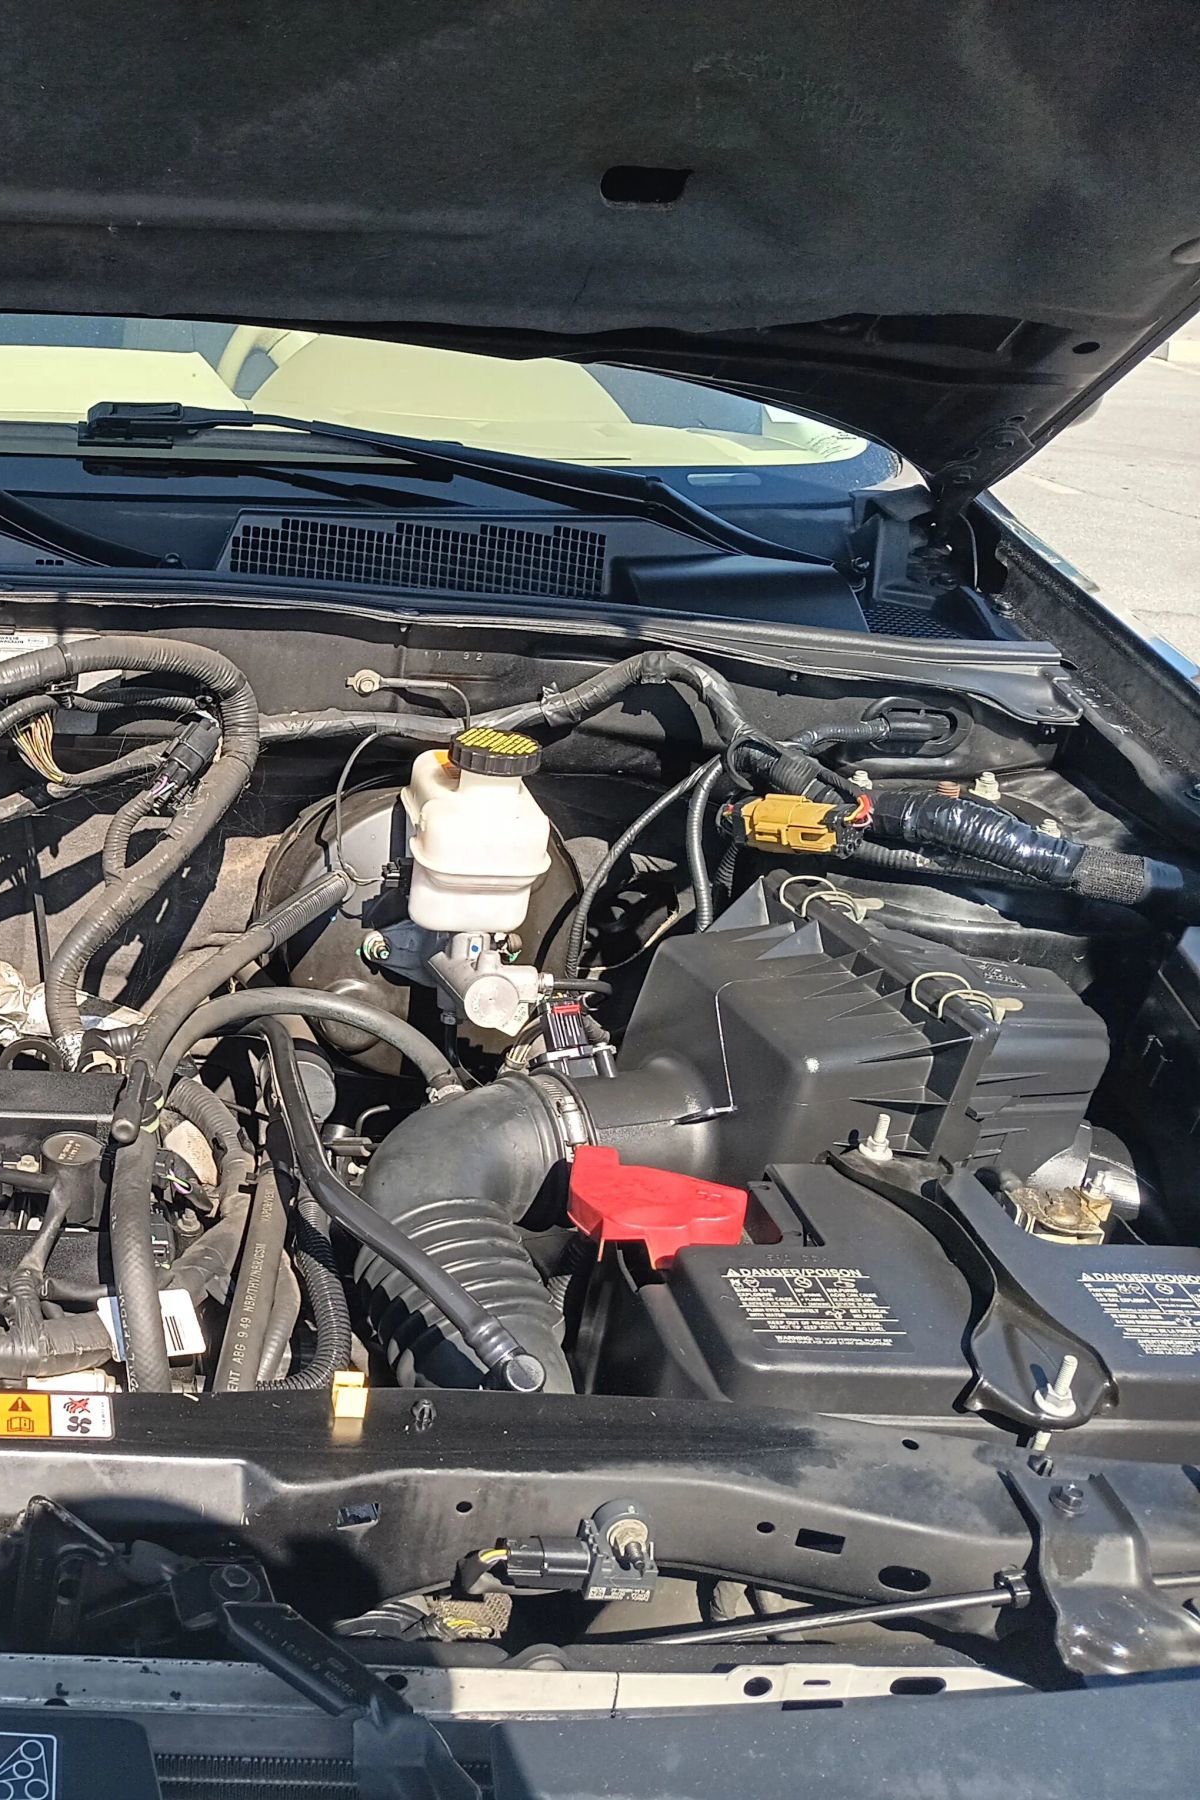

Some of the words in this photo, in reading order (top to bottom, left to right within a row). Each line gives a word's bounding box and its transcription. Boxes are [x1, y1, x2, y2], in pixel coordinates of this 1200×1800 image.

[739, 1268, 862, 1277] DANGER/POISON
[1092, 1273, 1200, 1284] DANGER/POISO
[222, 1344, 236, 1365] ABG
[230, 1317, 242, 1329] 49
